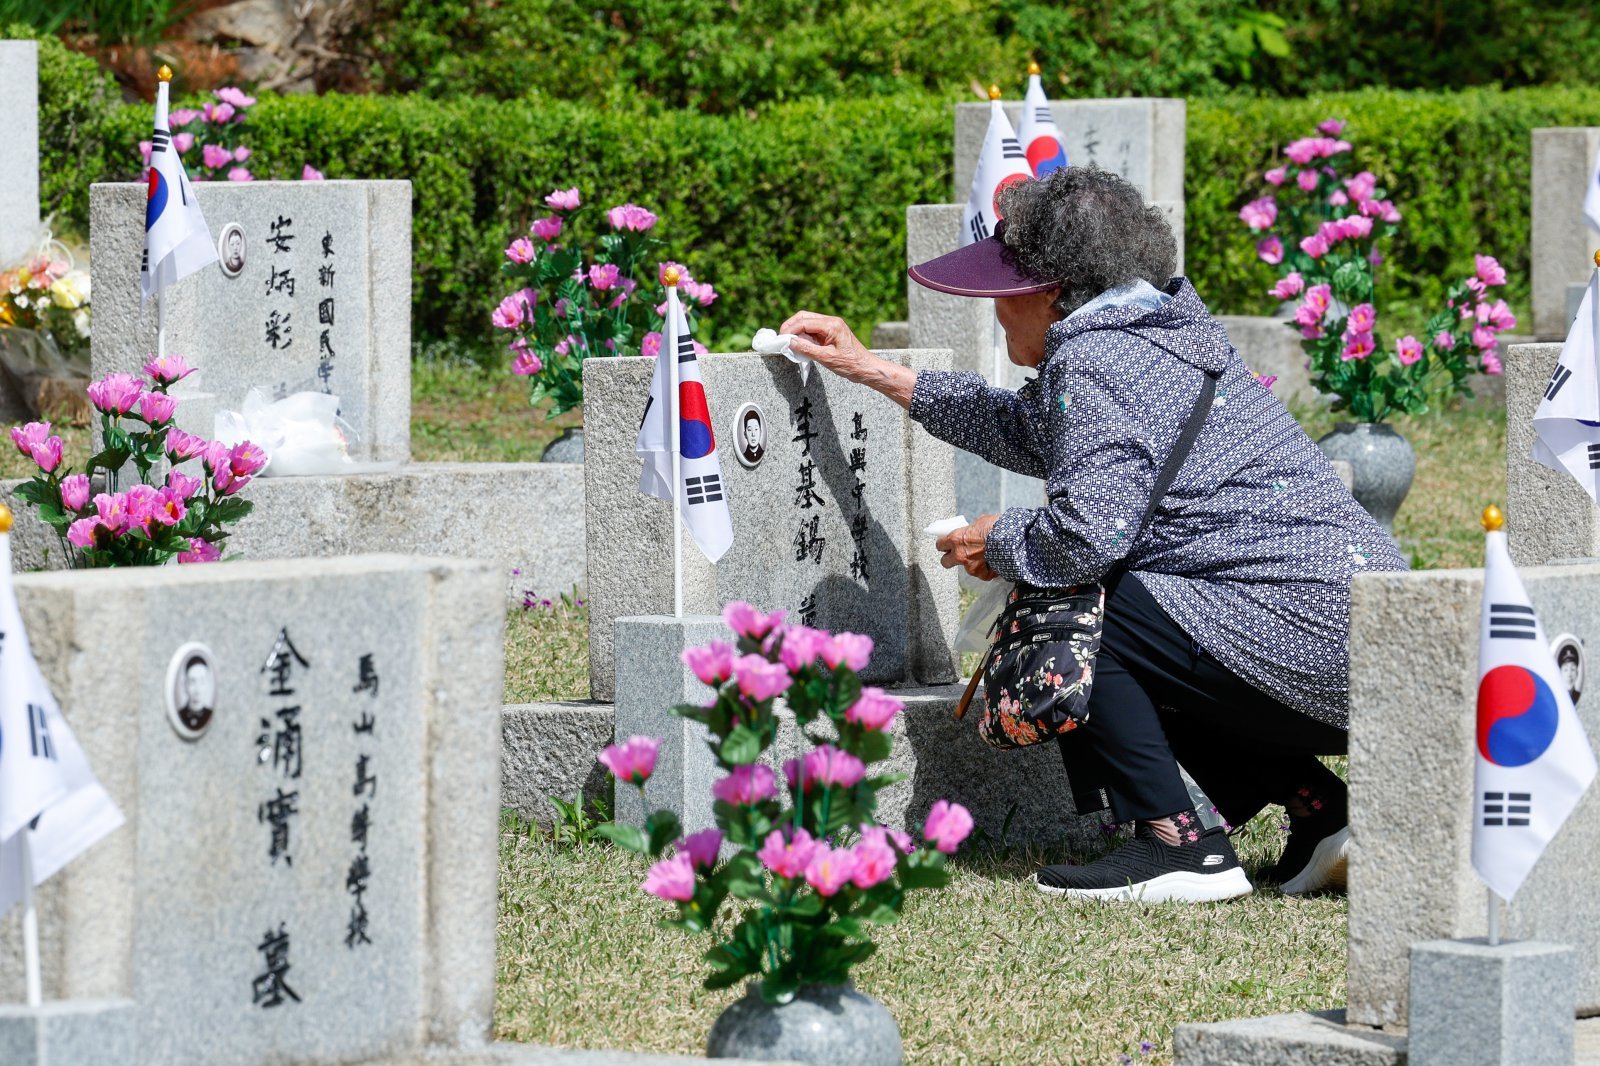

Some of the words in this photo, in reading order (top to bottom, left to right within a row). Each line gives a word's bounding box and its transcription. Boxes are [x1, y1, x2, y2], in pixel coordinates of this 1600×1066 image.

[265, 215, 296, 350] 安炳彩
[317, 230, 336, 396] 東新國民學
